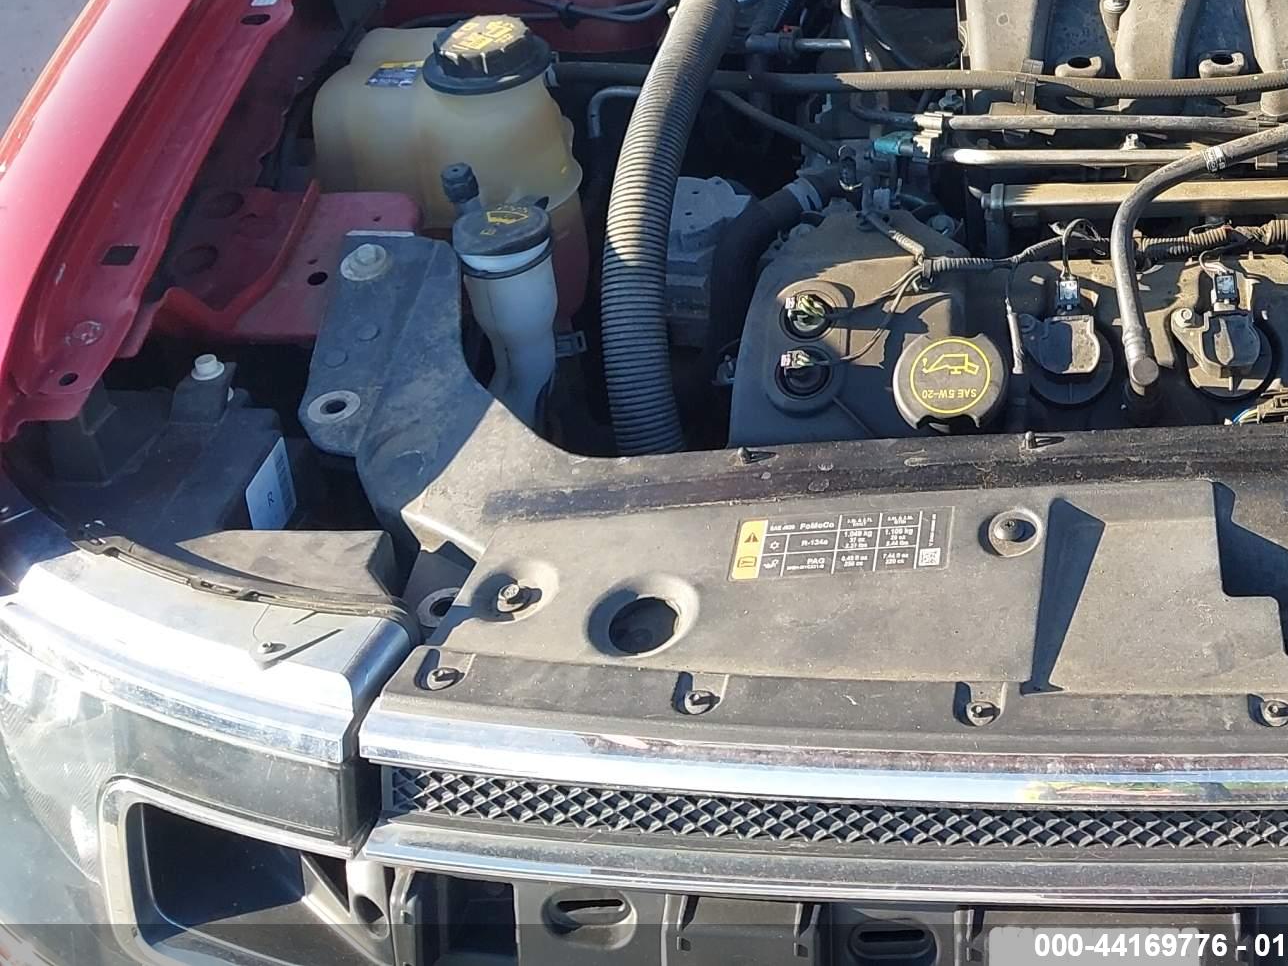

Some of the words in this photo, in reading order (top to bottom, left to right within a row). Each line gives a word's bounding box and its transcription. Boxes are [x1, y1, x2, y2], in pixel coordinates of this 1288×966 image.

[922, 388, 955, 399] 5W-20
[957, 388, 977, 398] SAE
[266, 491, 274, 506] R
[800, 521, 834, 530] FoMoCo
[863, 530, 873, 538] kg
[904, 528, 914, 536] kg
[801, 539, 829, 547] R-134a
[807, 557, 825, 565] PAG
